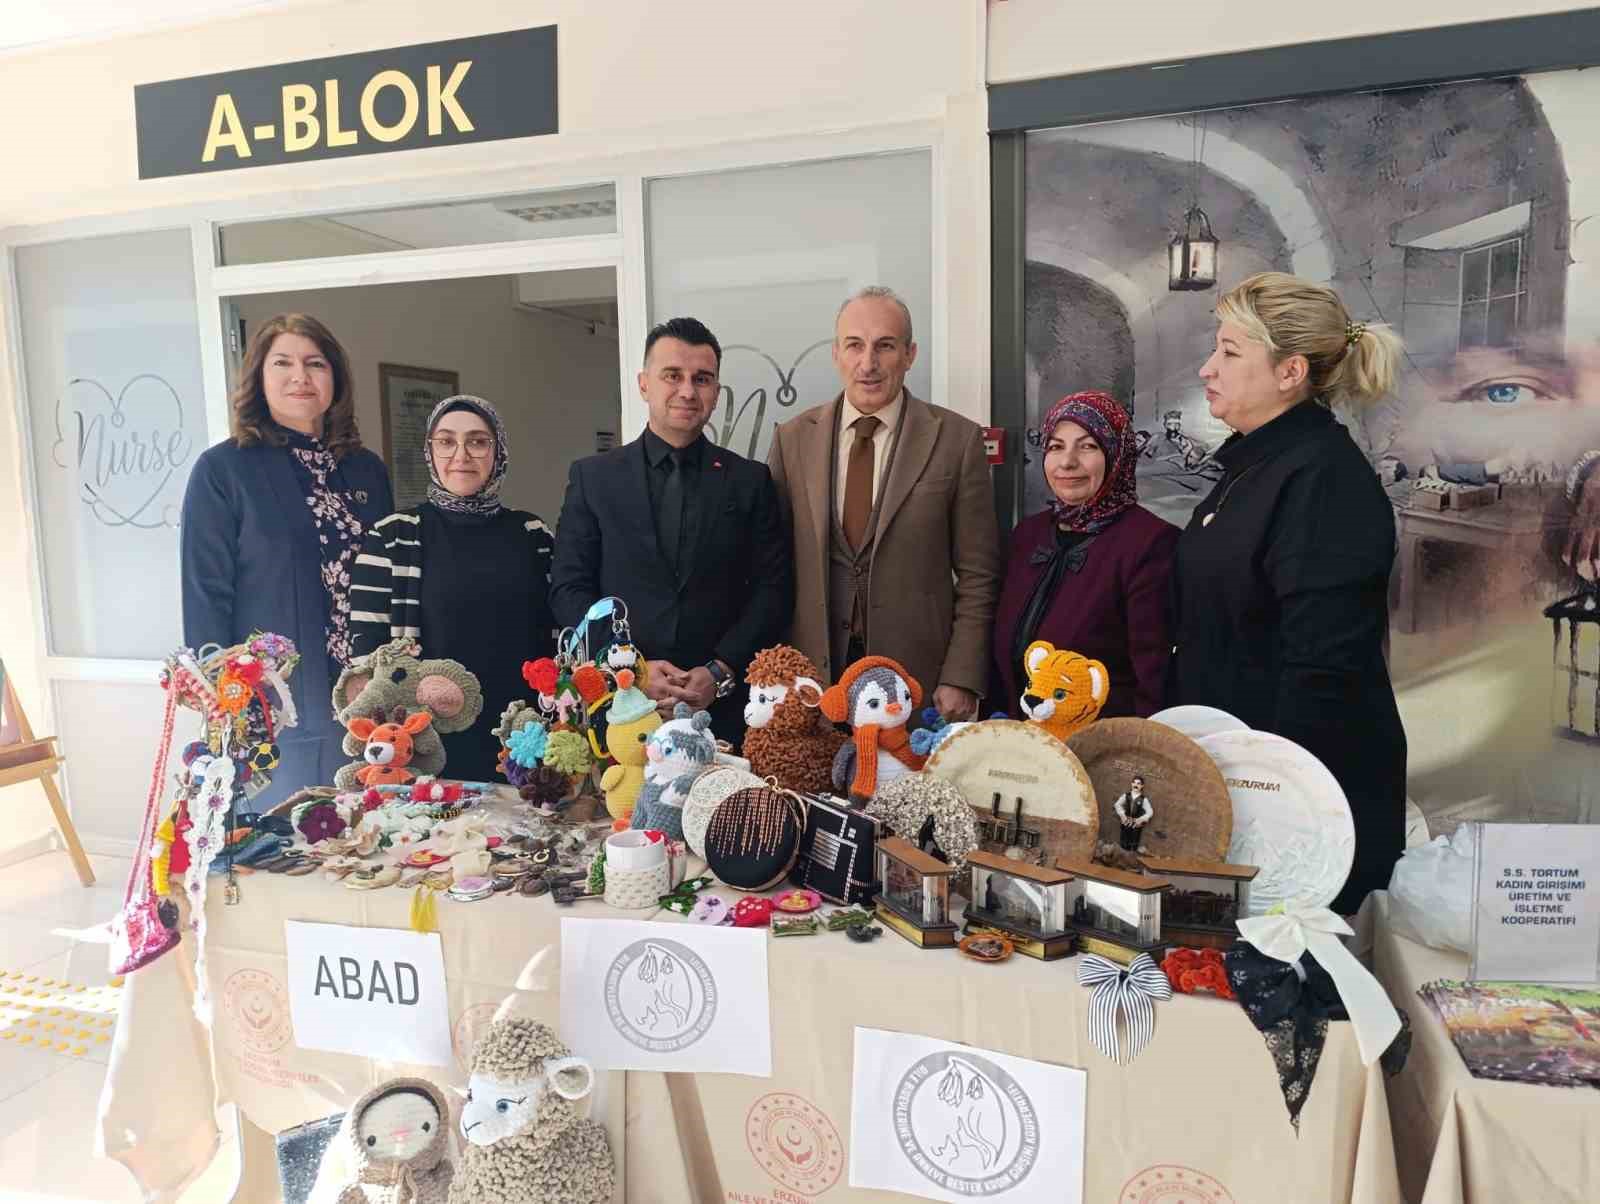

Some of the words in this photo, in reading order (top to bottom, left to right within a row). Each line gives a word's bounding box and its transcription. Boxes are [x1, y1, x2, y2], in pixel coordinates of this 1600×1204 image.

[202, 60, 475, 162] A-BLOK
[74, 411, 192, 488] Nurse
[1496, 880, 1533, 889] KADIN
[1503, 868, 1527, 878] S.S.
[1531, 868, 1579, 878] TORTUM
[1556, 892, 1572, 901] VE
[314, 955, 420, 1006] ABAD
